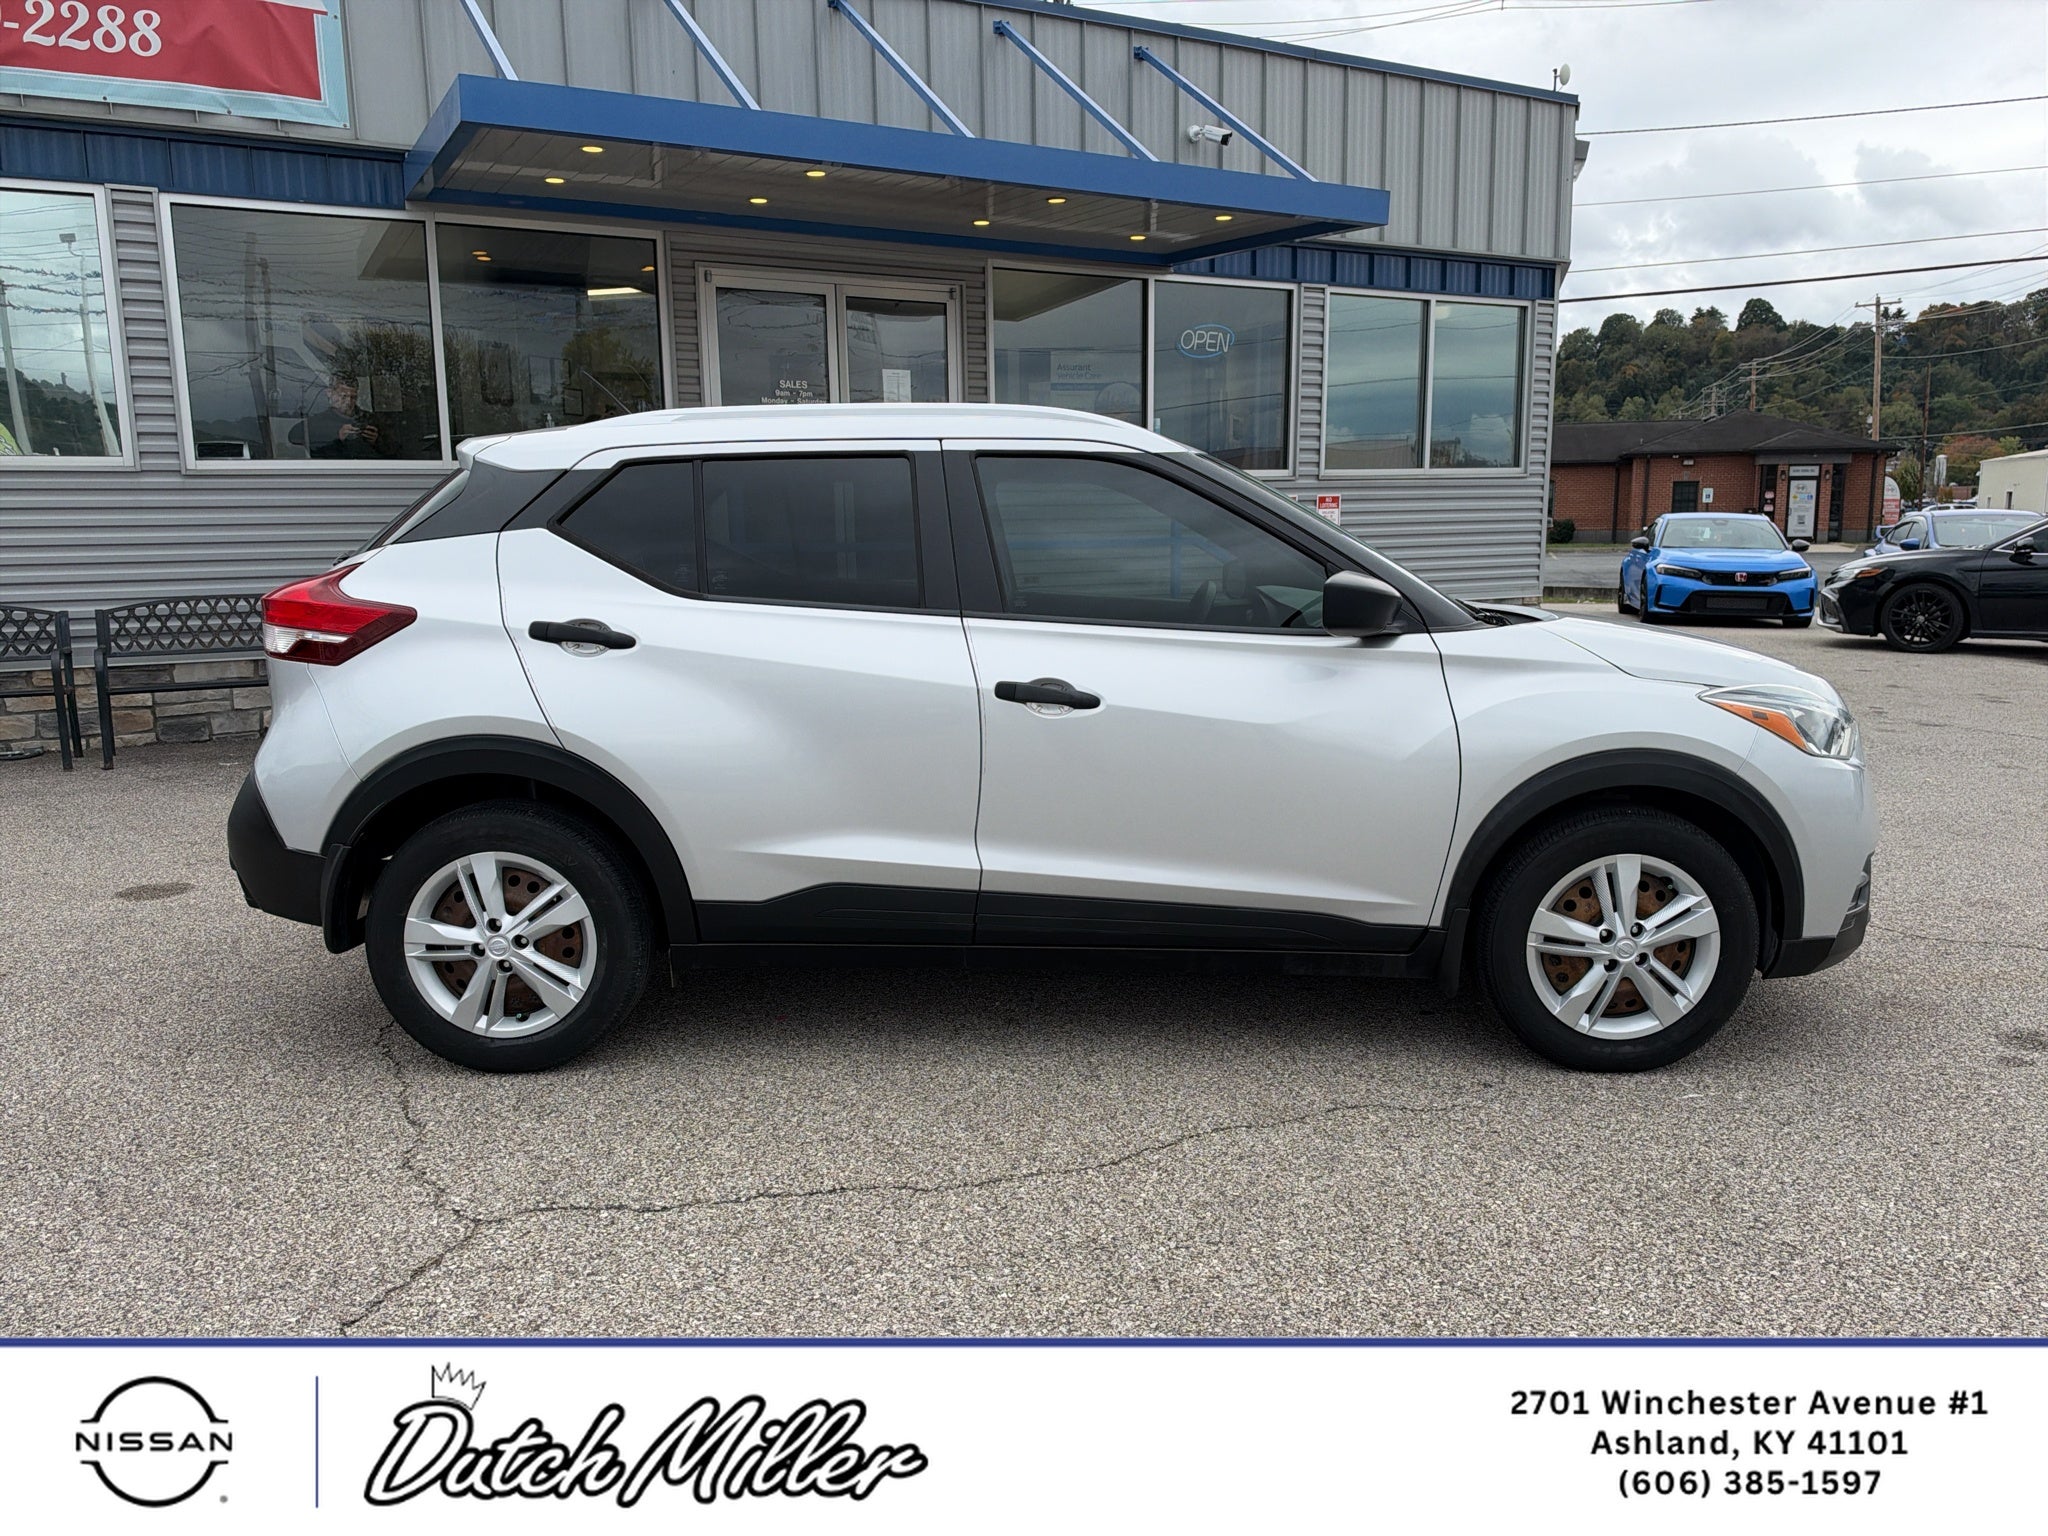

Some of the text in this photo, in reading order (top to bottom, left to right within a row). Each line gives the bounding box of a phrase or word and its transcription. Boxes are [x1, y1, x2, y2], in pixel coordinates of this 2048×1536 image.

[0, 0, 162, 57] -2288
[1180, 329, 1232, 353] OPEN
[1056, 363, 1092, 371] Assurant
[779, 379, 808, 389] SALES
[775, 389, 790, 397] 9am
[799, 390, 814, 398] 7pm
